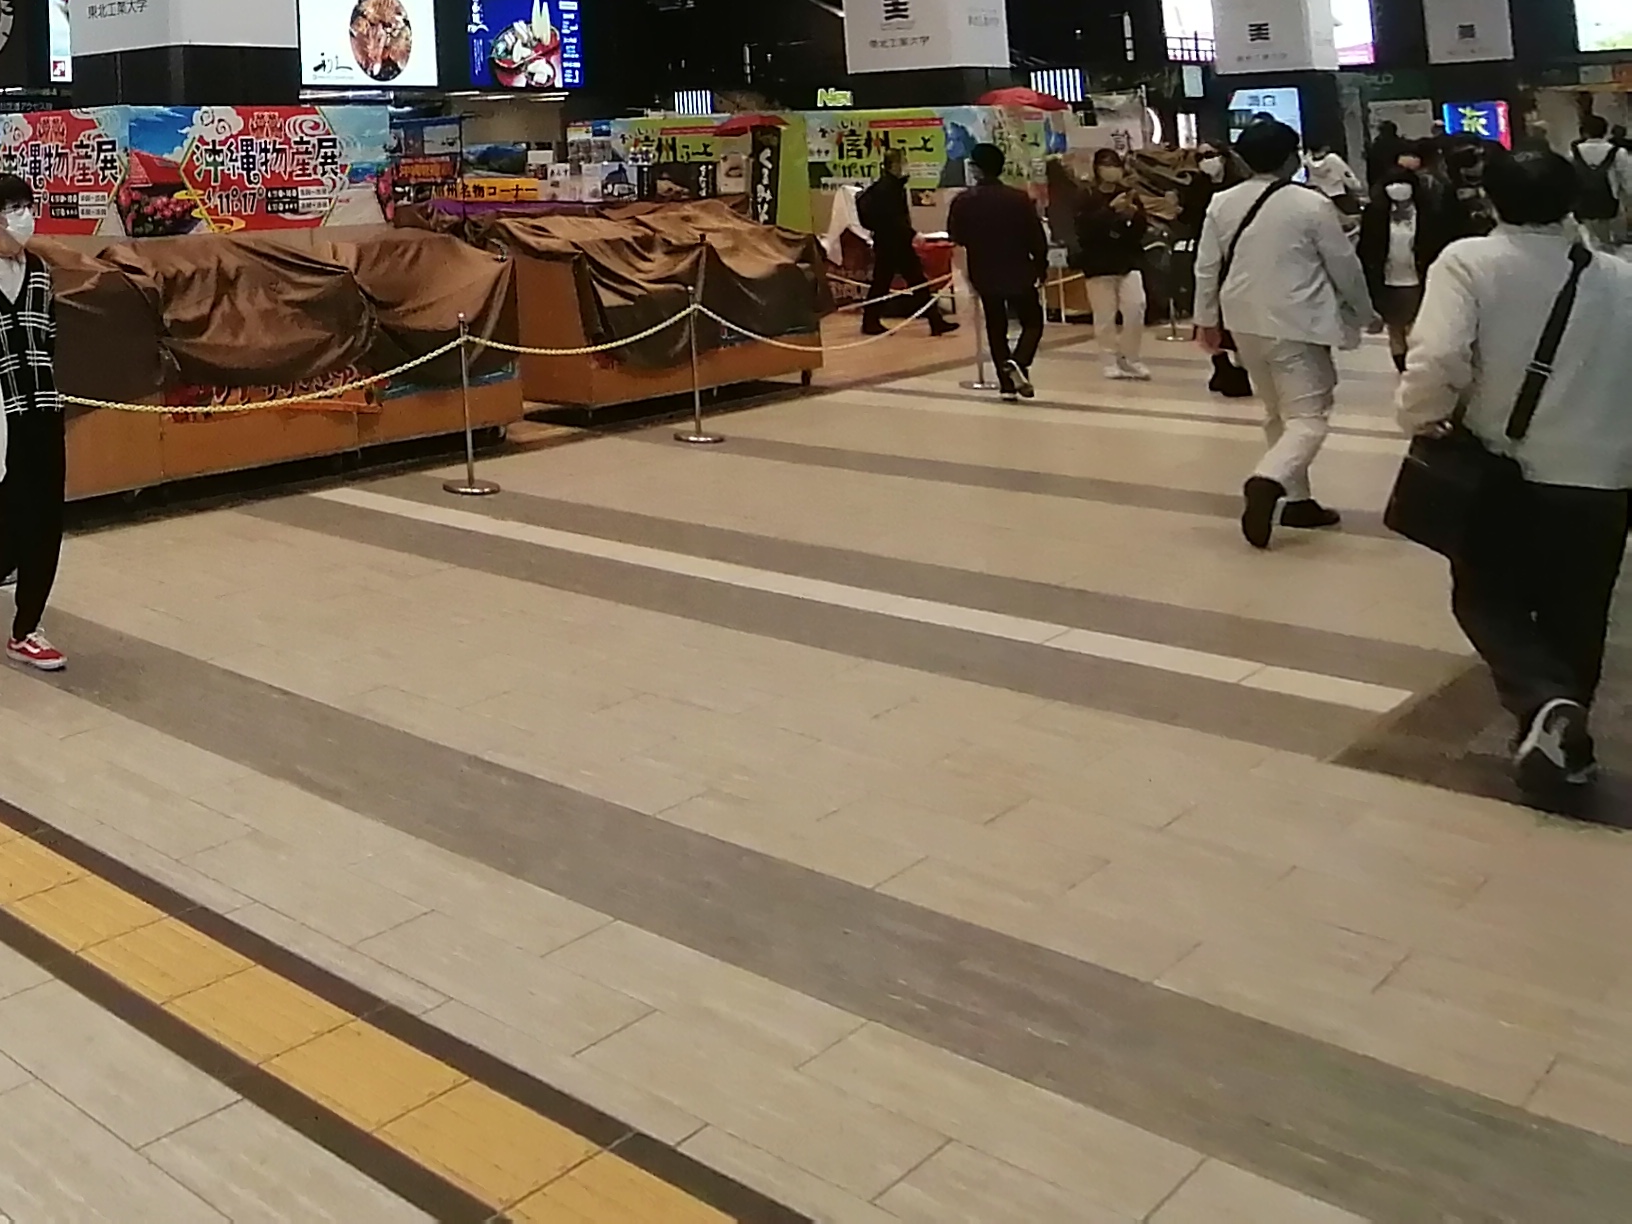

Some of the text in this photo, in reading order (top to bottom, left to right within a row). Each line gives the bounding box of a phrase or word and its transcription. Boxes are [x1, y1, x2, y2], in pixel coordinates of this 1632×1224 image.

[193, 136, 340, 187] 沖縄物産展
